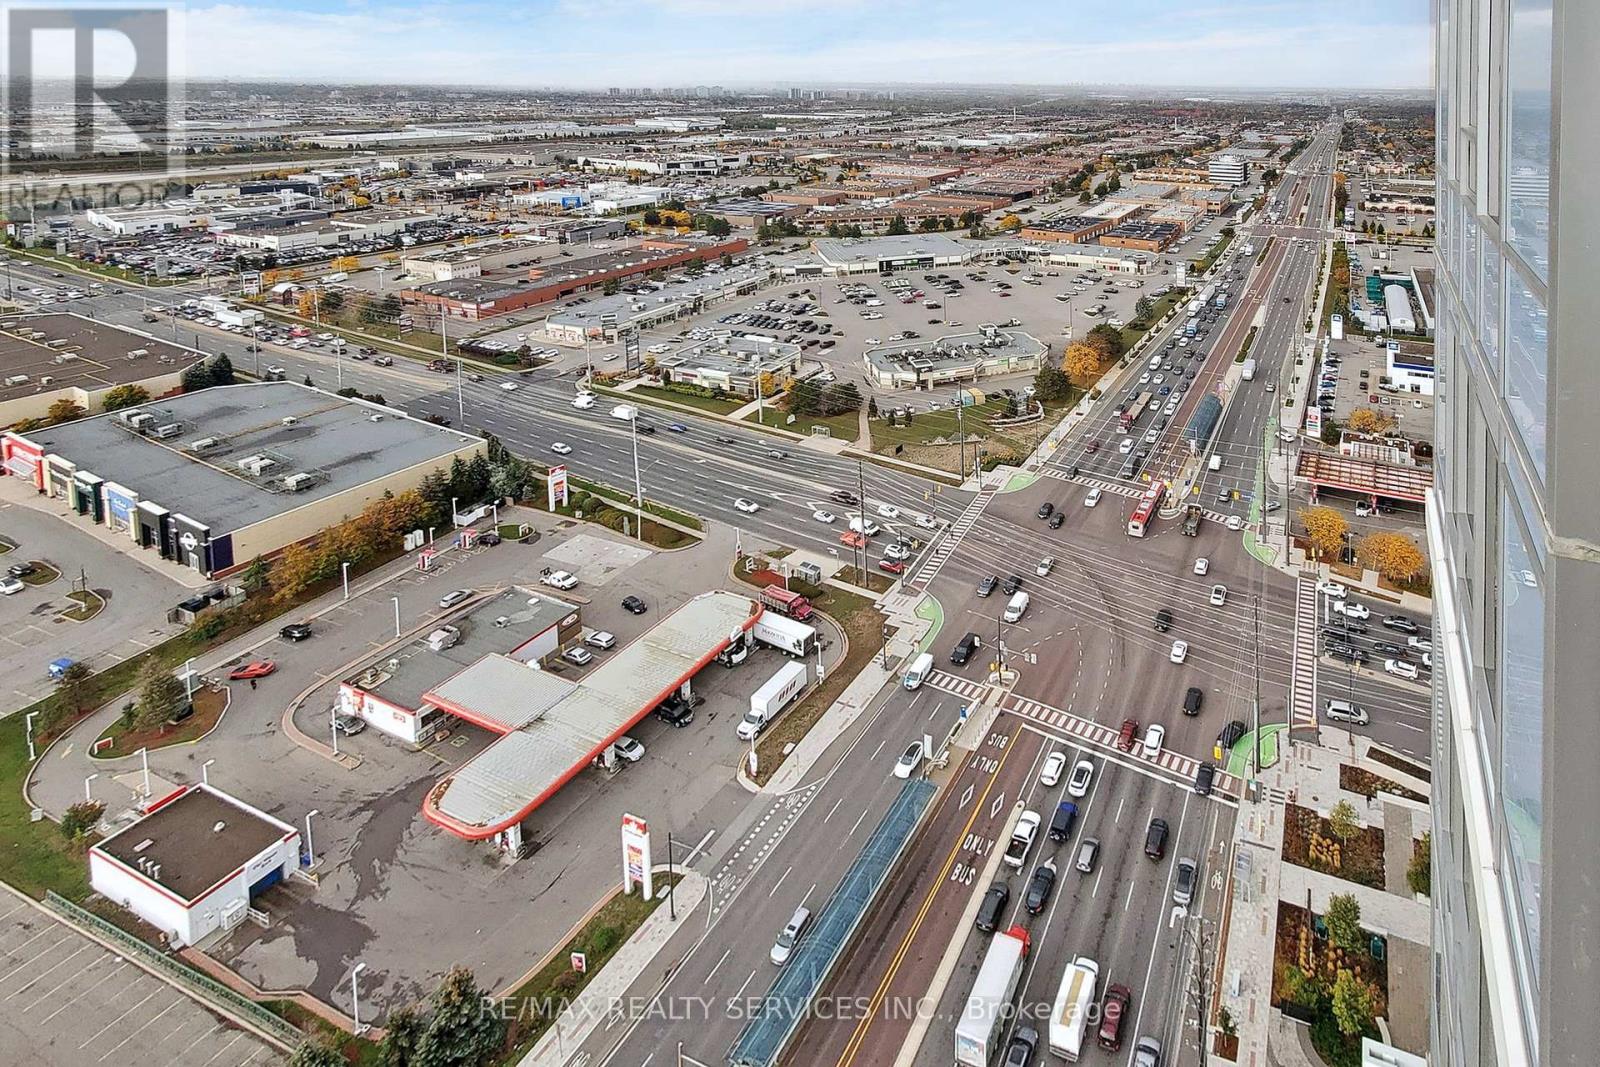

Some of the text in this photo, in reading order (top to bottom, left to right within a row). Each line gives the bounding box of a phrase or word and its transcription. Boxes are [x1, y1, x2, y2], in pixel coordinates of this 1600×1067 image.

[988, 733, 1009, 749] BUS
[971, 755, 998, 774] ONLY
[963, 833, 994, 857] ONLY
[951, 863, 976, 886] BUS
